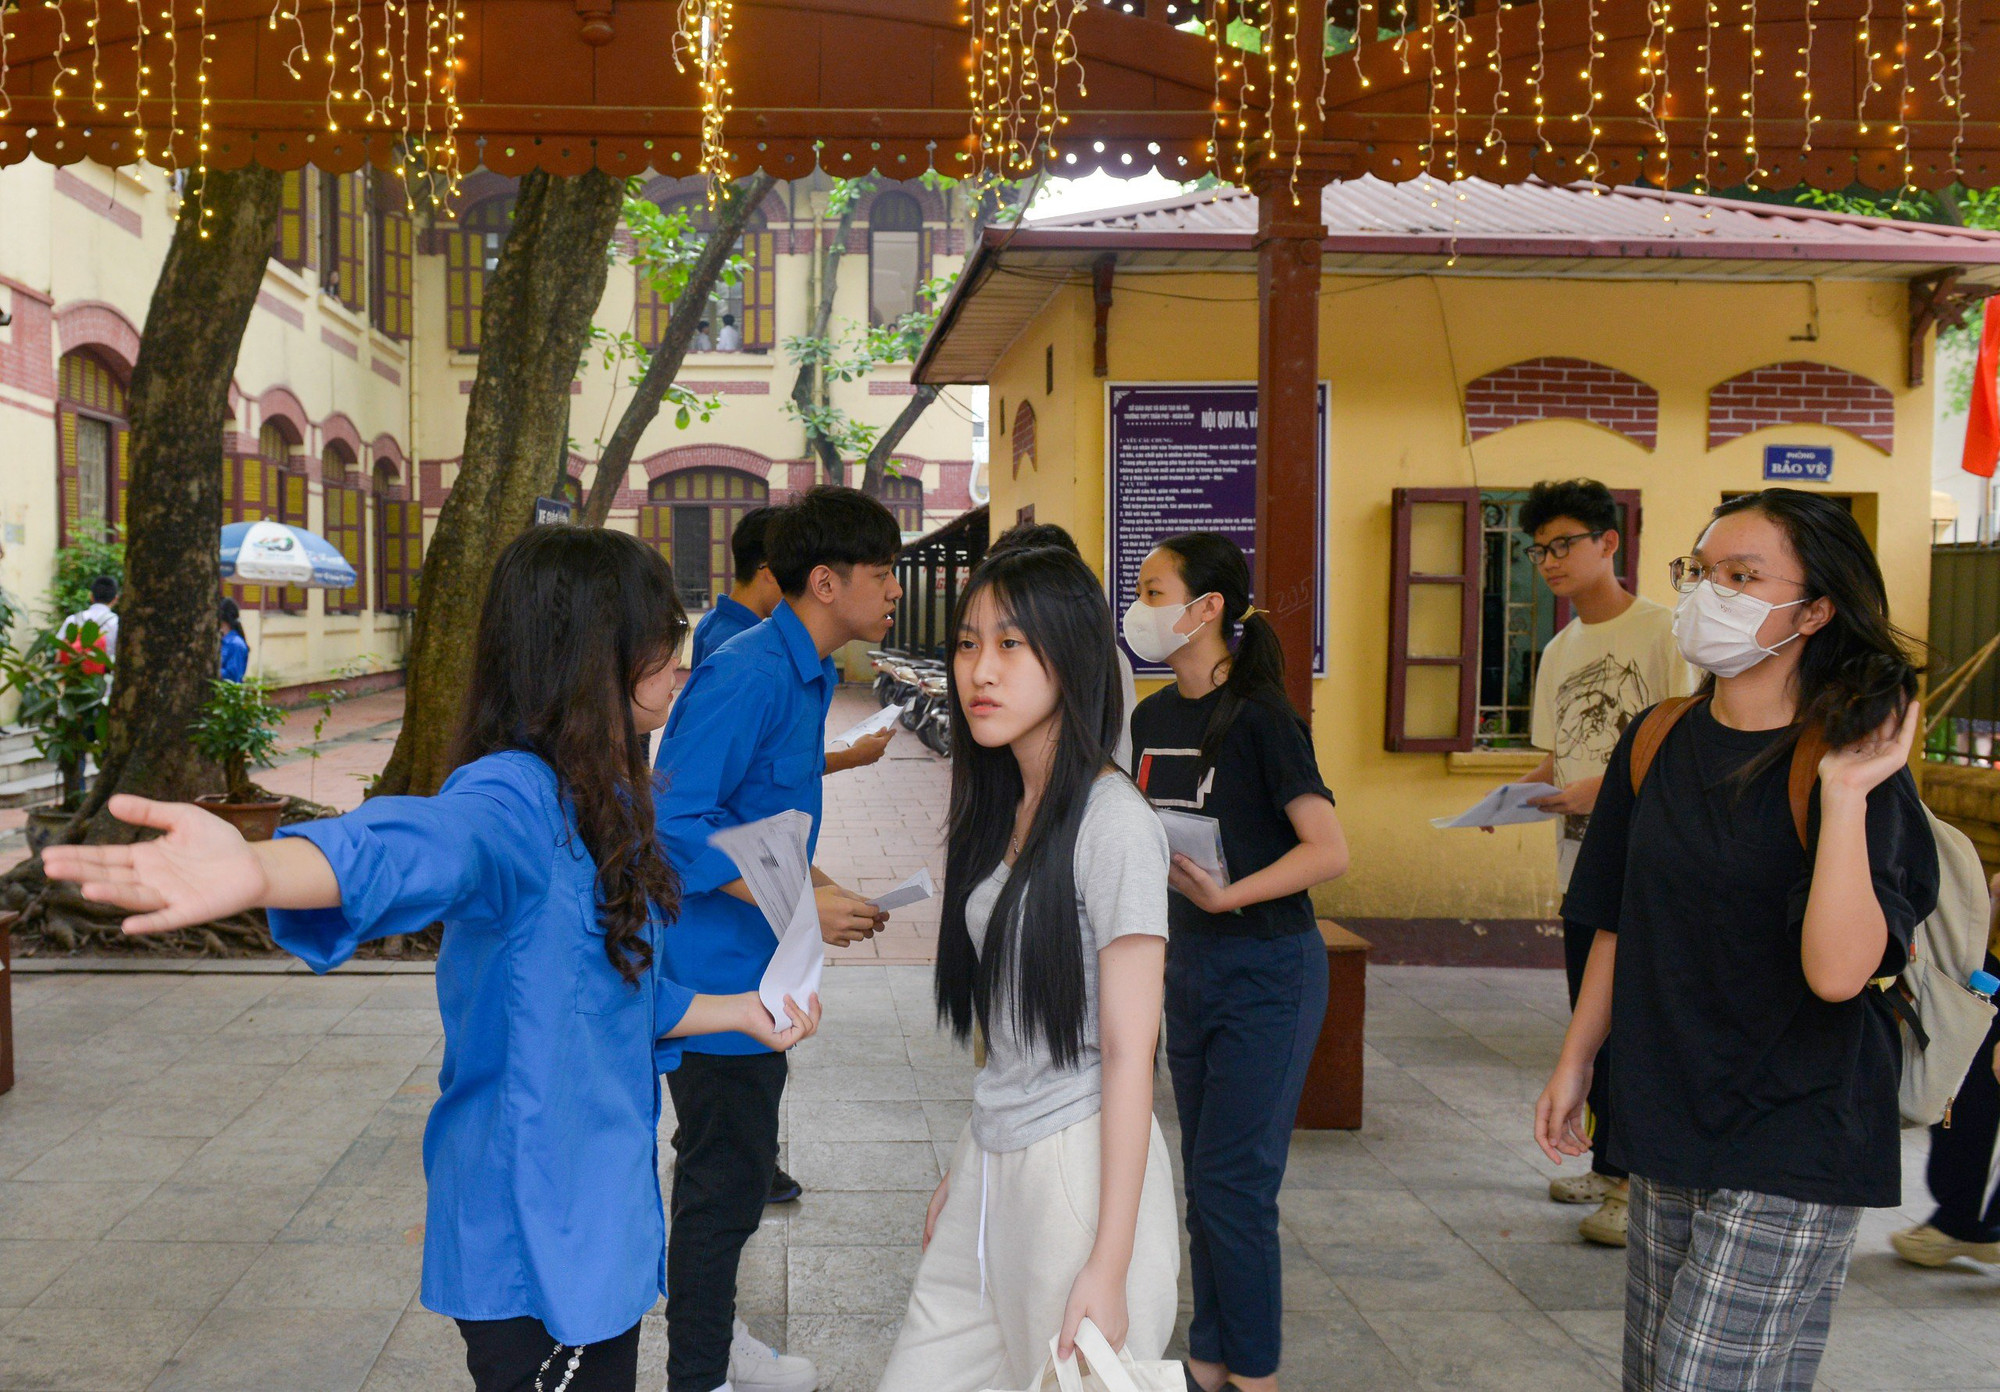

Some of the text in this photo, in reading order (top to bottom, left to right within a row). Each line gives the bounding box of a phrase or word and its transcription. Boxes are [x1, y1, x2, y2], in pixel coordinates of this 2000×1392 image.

[1201, 408, 1216, 432] NỘI
[1217, 410, 1233, 430] QUY
[1786, 450, 1816, 460] PHÒNG
[1771, 460, 1827, 476] BẢO VỆ
